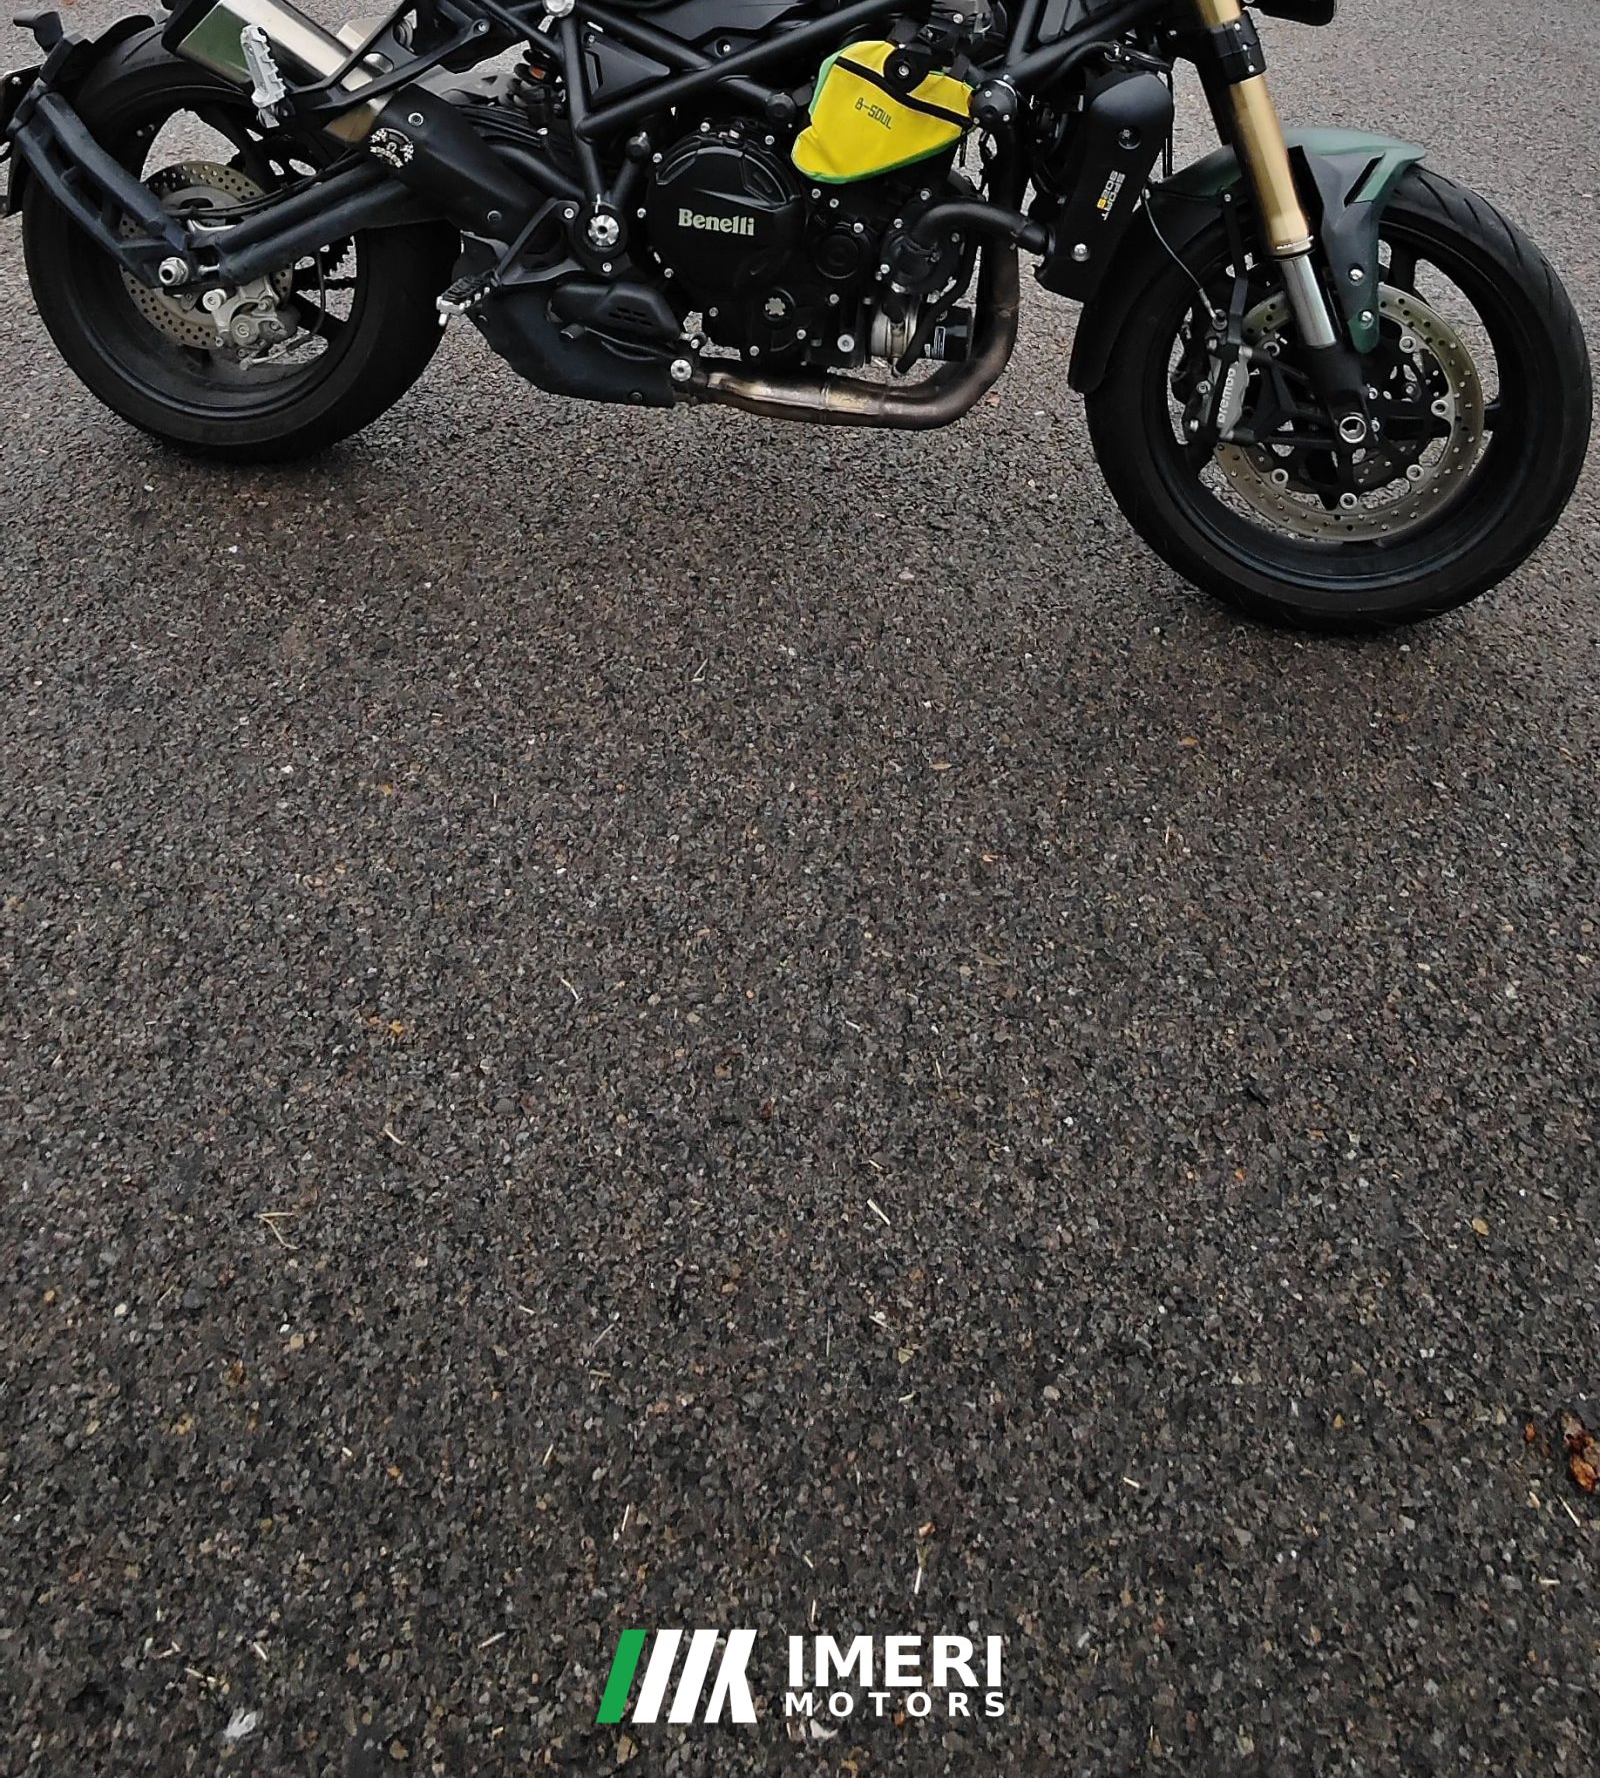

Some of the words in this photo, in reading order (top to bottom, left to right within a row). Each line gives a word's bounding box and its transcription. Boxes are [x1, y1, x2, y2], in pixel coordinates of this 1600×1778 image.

[854, 97, 892, 130] B-SOUL
[1101, 172, 1125, 221] SPORT
[678, 208, 754, 236] Benelli
[1216, 367, 1237, 424] brembo
